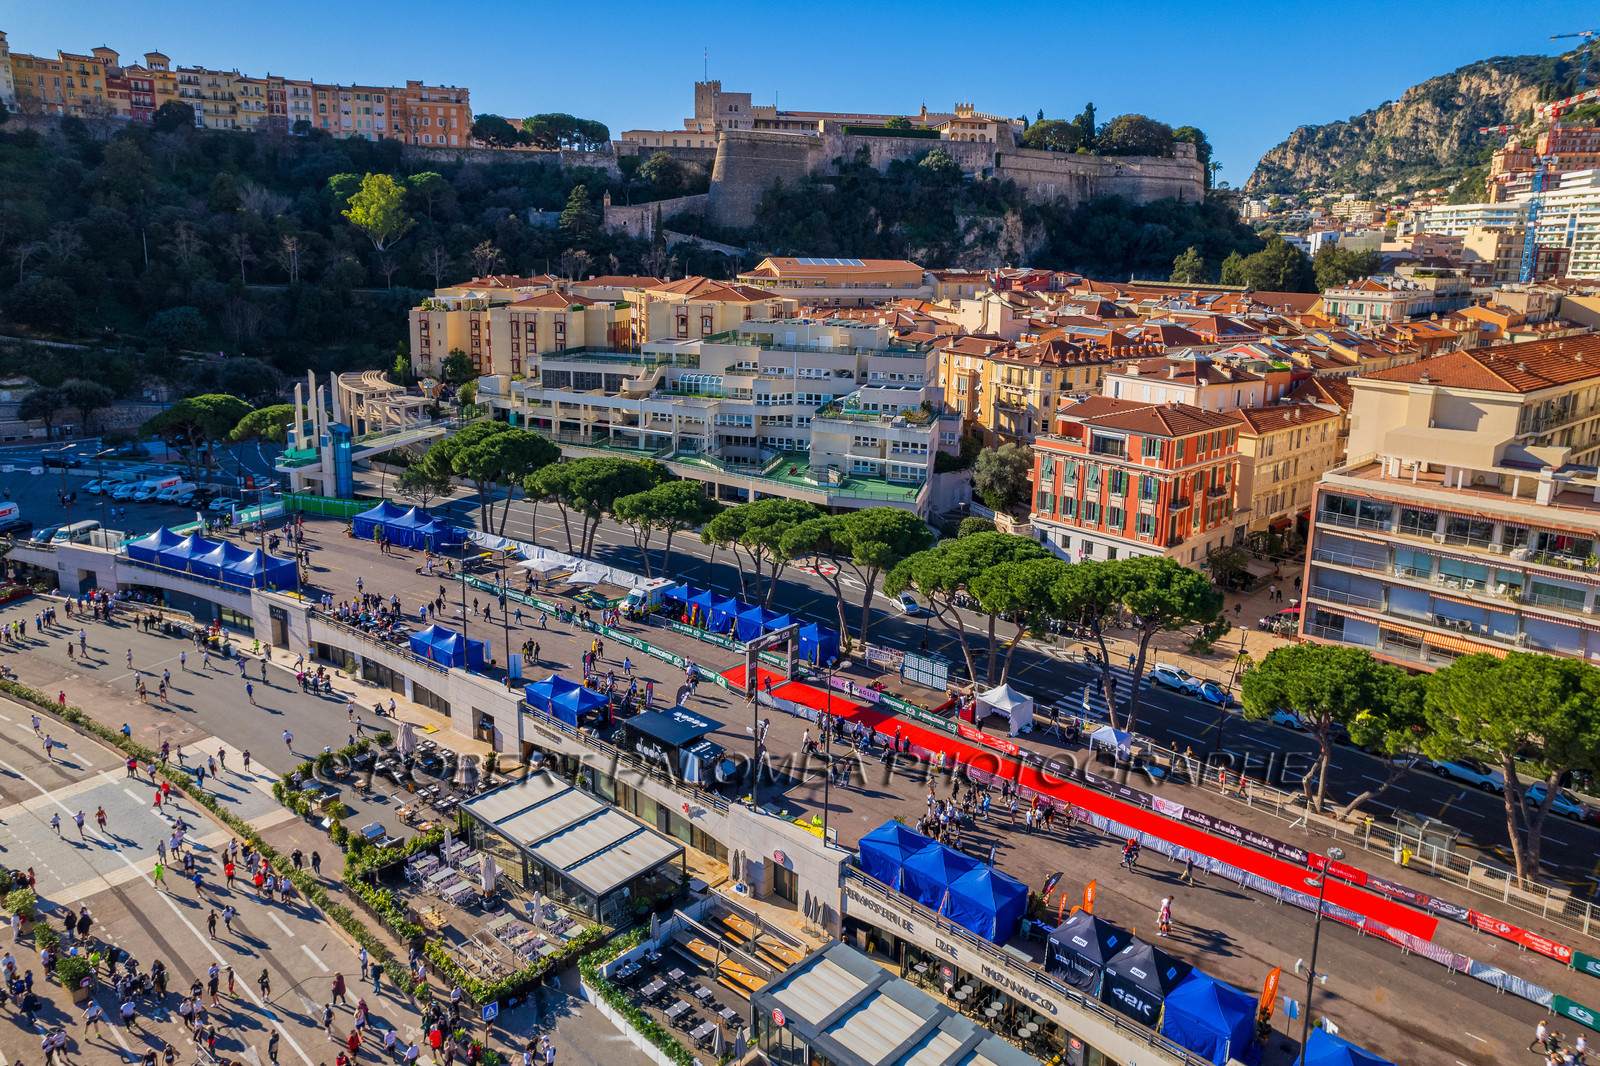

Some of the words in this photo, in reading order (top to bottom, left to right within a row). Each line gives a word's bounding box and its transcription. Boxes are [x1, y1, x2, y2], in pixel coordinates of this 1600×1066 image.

[841, 682, 877, 700] GRMAGLIA
[843, 885, 912, 933] BRASSERIE
[935, 937, 955, 955] DE
[980, 963, 1055, 1012] MONACO
[1524, 932, 1553, 947] Carrefour
[1112, 986, 1152, 1017] 42K
